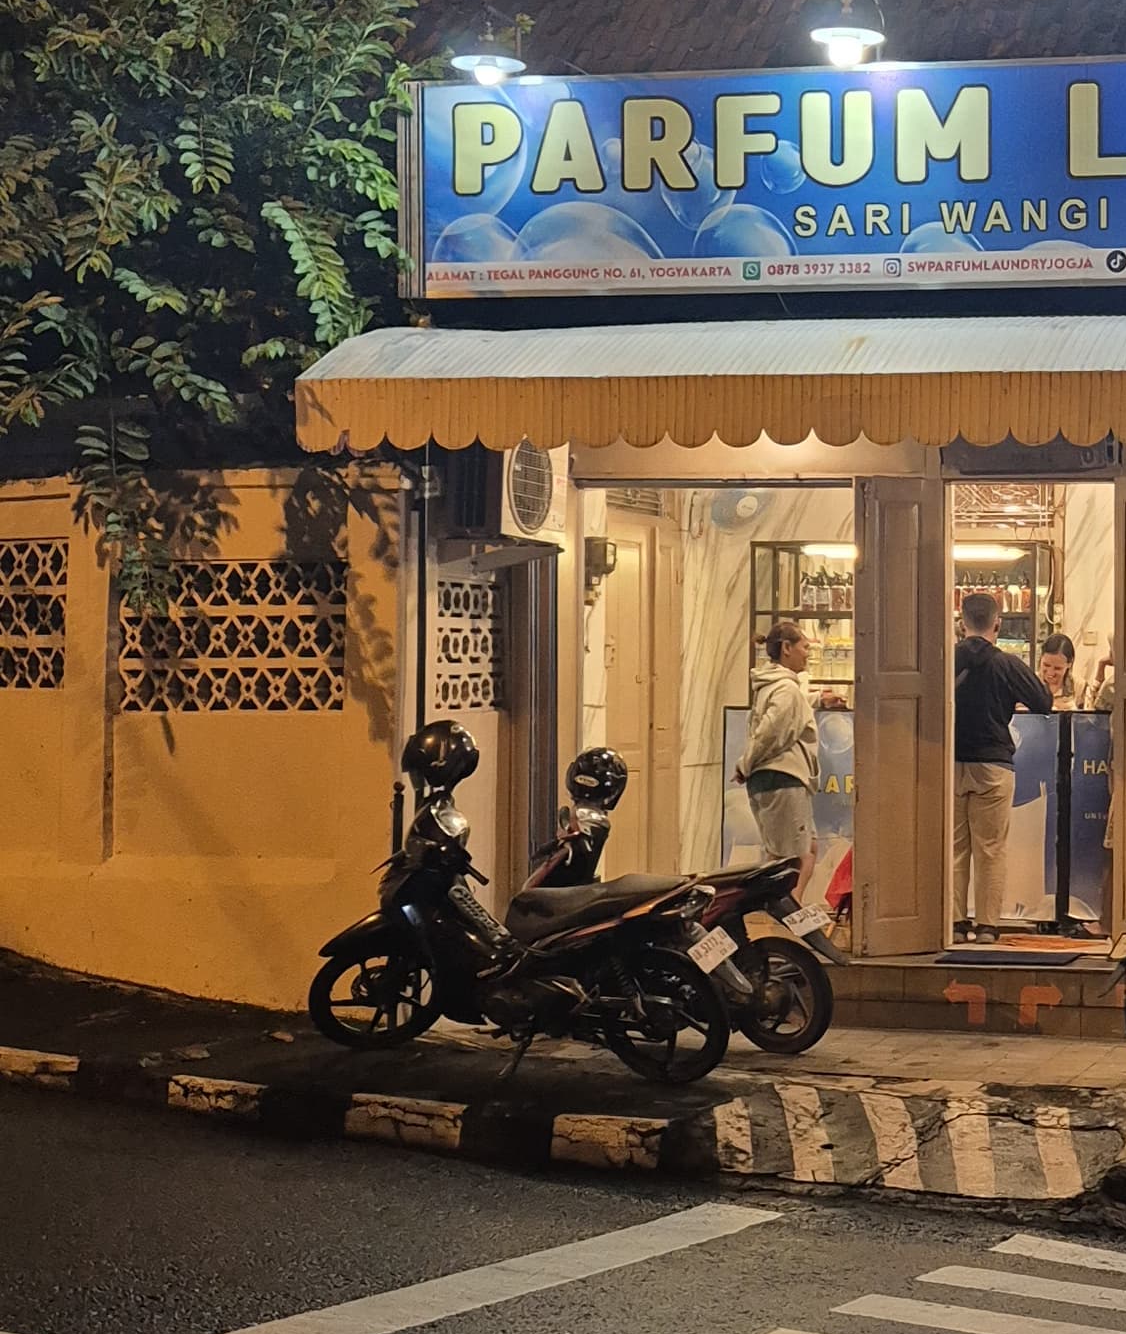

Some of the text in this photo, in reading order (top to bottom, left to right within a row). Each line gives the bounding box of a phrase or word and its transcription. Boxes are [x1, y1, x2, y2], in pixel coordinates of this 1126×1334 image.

[451, 84, 991, 195] PARFUM
[794, 202, 912, 237] SARI
[940, 196, 1109, 234] WANGI
[767, 262, 871, 276] 0878 3937 3382
[907, 257, 1094, 273] SWPARFUMLAUNDRYJOGJA
[426, 271, 475, 282] ALAMAT
[486, 269, 525, 280] TEGAL
[528, 268, 600, 280] PANGGUNG
[604, 269, 627, 280] NO.
[629, 269, 646, 280] 61,
[649, 266, 732, 278] YOGYAKARTA
